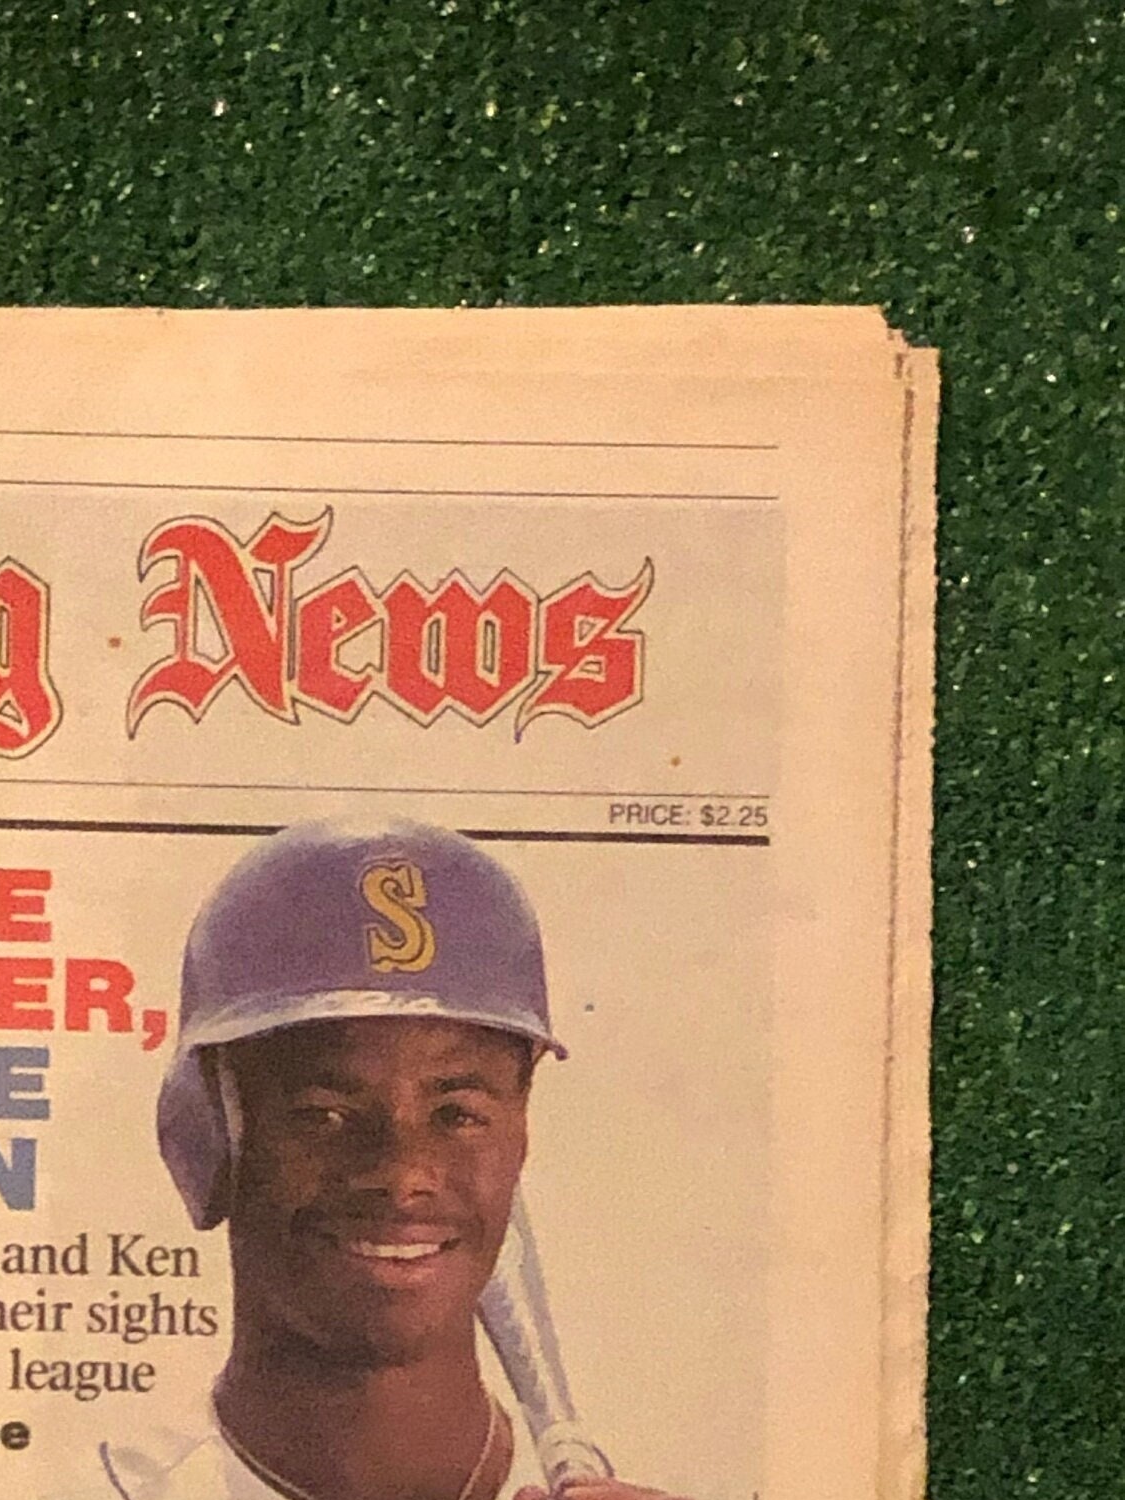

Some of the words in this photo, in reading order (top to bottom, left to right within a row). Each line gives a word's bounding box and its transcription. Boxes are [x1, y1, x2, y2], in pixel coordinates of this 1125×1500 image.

[127, 504, 655, 743] News
[608, 801, 693, 827] PRICE:
[700, 803, 769, 829] $2.25
[359, 857, 435, 974] S
[1, 1233, 88, 1276] and
[108, 1235, 200, 1279] Ken
[86, 1295, 219, 1343] sights
[10, 1348, 155, 1402] league
